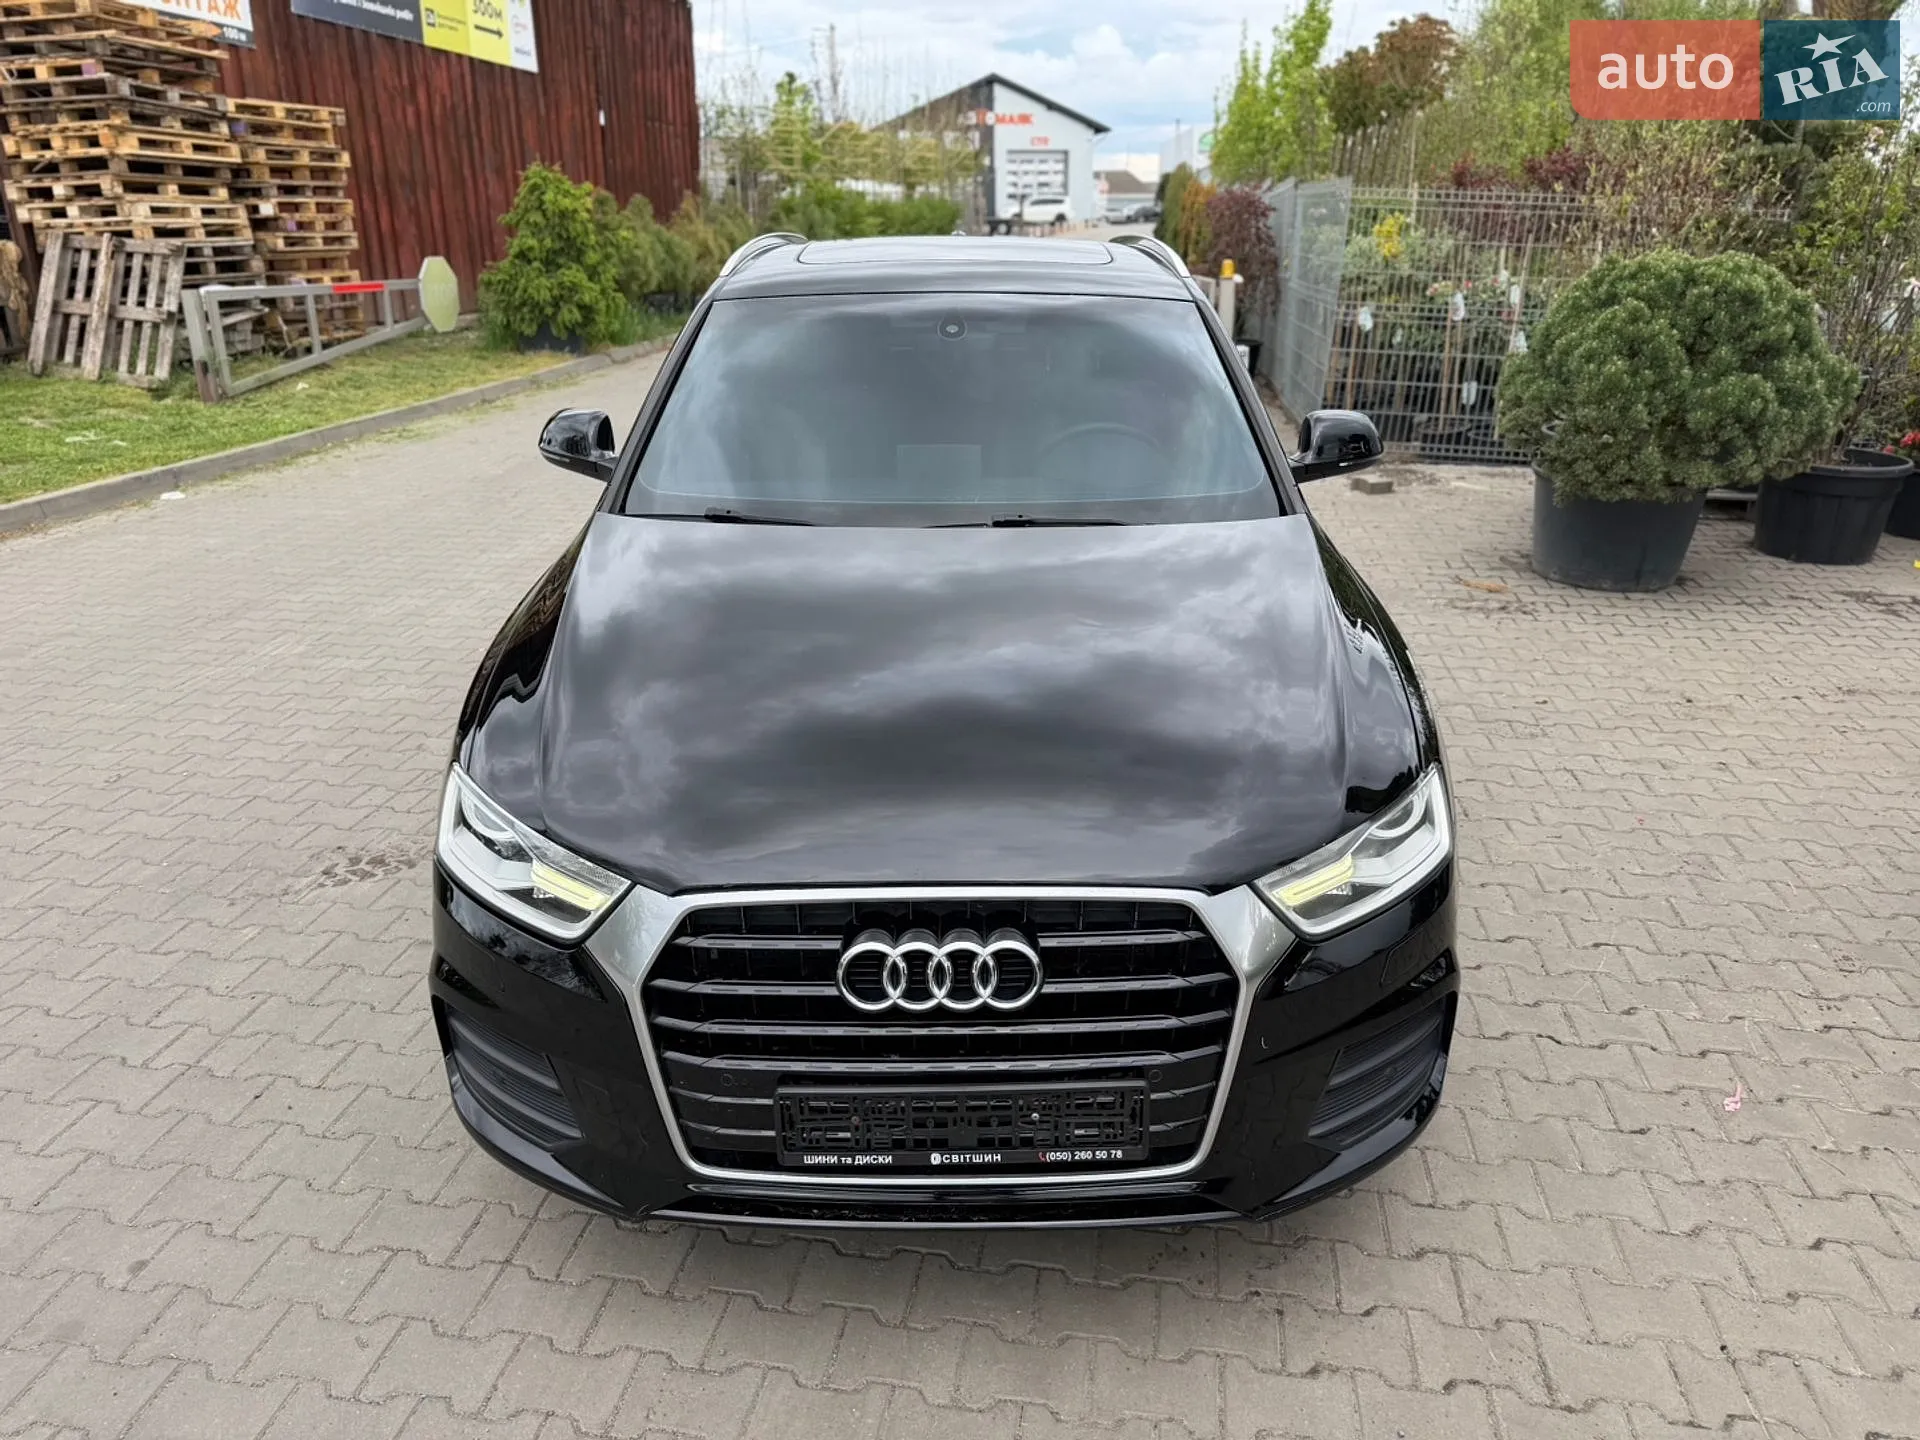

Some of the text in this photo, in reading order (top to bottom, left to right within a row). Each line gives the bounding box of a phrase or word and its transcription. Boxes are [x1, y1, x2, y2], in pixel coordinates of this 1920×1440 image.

[804, 1155, 838, 1164] ШИНИ
[854, 1154, 893, 1166] ДИСКИ
[943, 1153, 1001, 1163] СВІТШИН
[1046, 1151, 1072, 1162] (050)
[1074, 1150, 1093, 1160] 260
[1094, 1150, 1108, 1159] 50
[1110, 1149, 1123, 1159] 78
